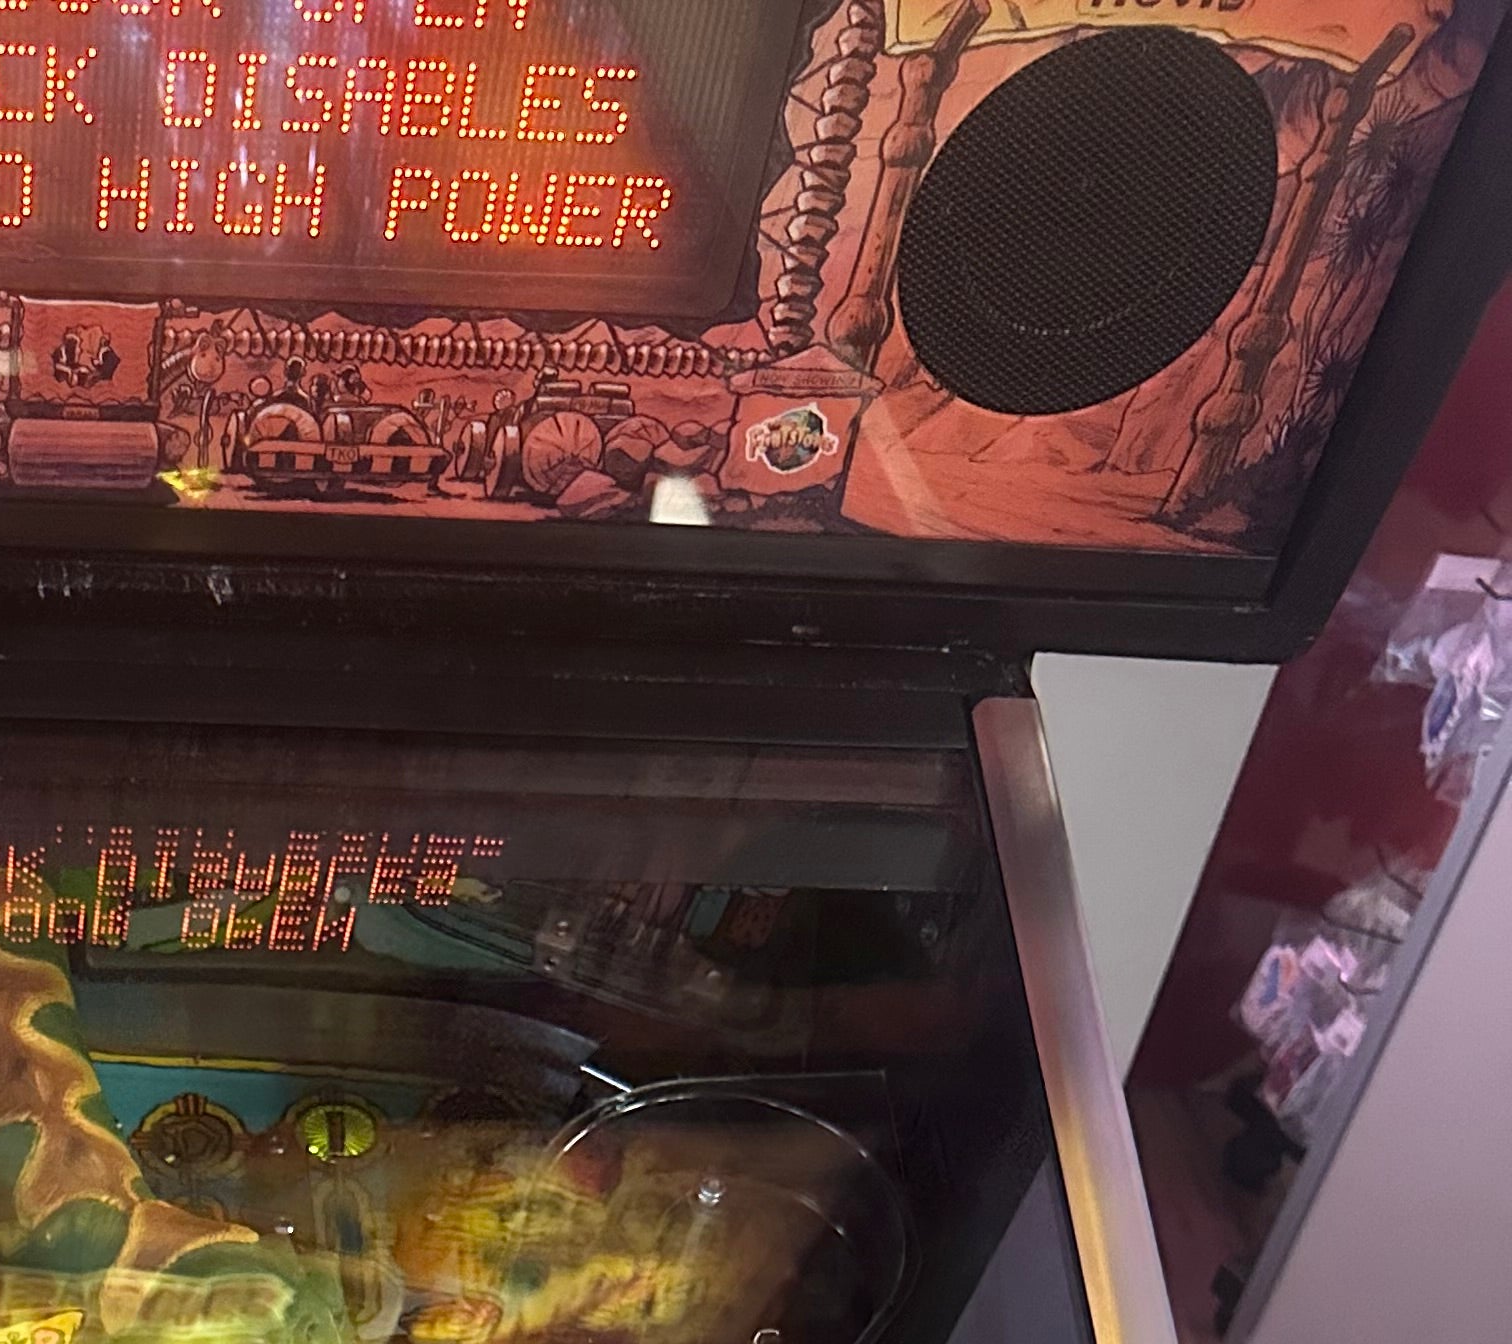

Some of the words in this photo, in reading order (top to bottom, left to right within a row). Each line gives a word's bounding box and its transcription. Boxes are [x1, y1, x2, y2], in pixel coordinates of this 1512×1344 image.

[161, 48, 637, 145] DISABLES
[95, 152, 326, 239] HIGH
[383, 165, 670, 250] POWER
